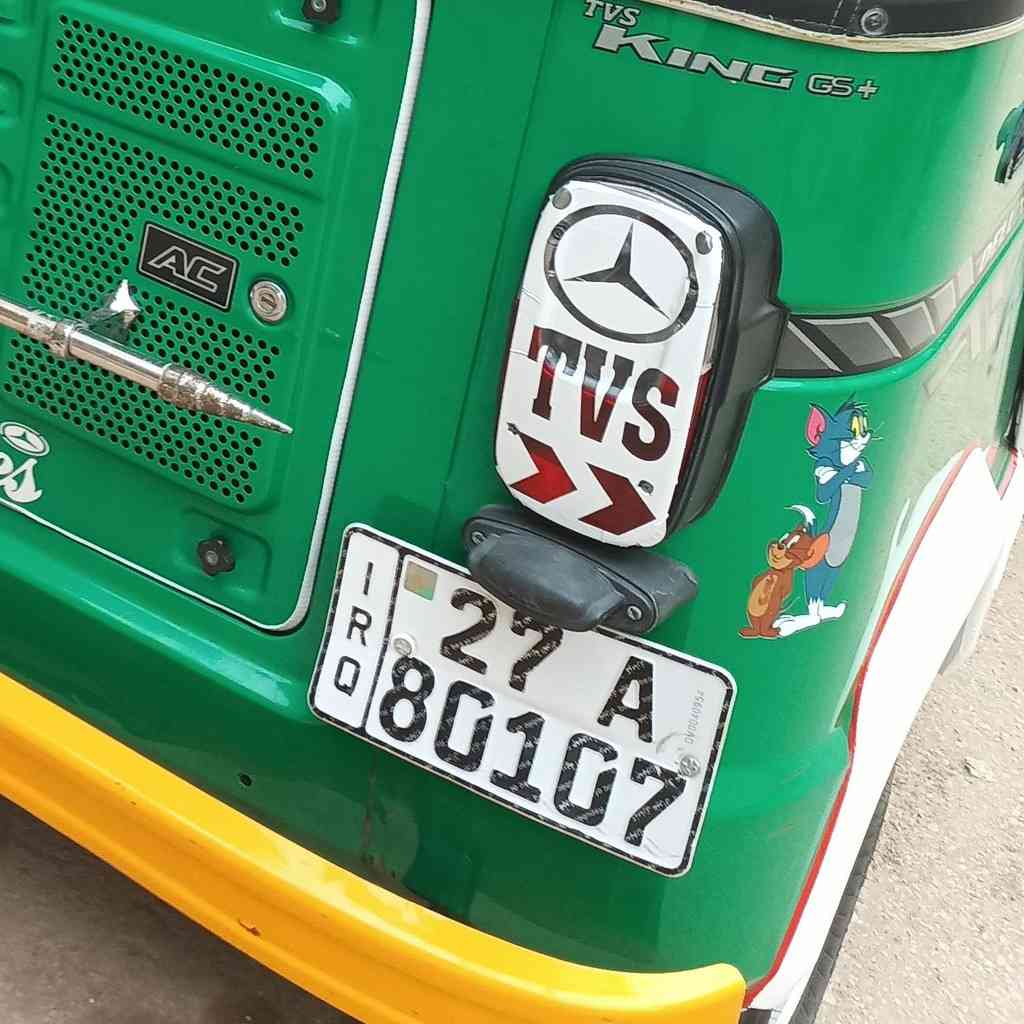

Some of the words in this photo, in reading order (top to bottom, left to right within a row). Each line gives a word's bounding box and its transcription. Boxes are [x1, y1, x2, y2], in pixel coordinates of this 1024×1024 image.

[147, 245, 227, 293] AC
[528, 325, 680, 462] TVS
[439, 587, 564, 693] 27
[597, 655, 656, 744] A
[378, 656, 687, 848] 80107
